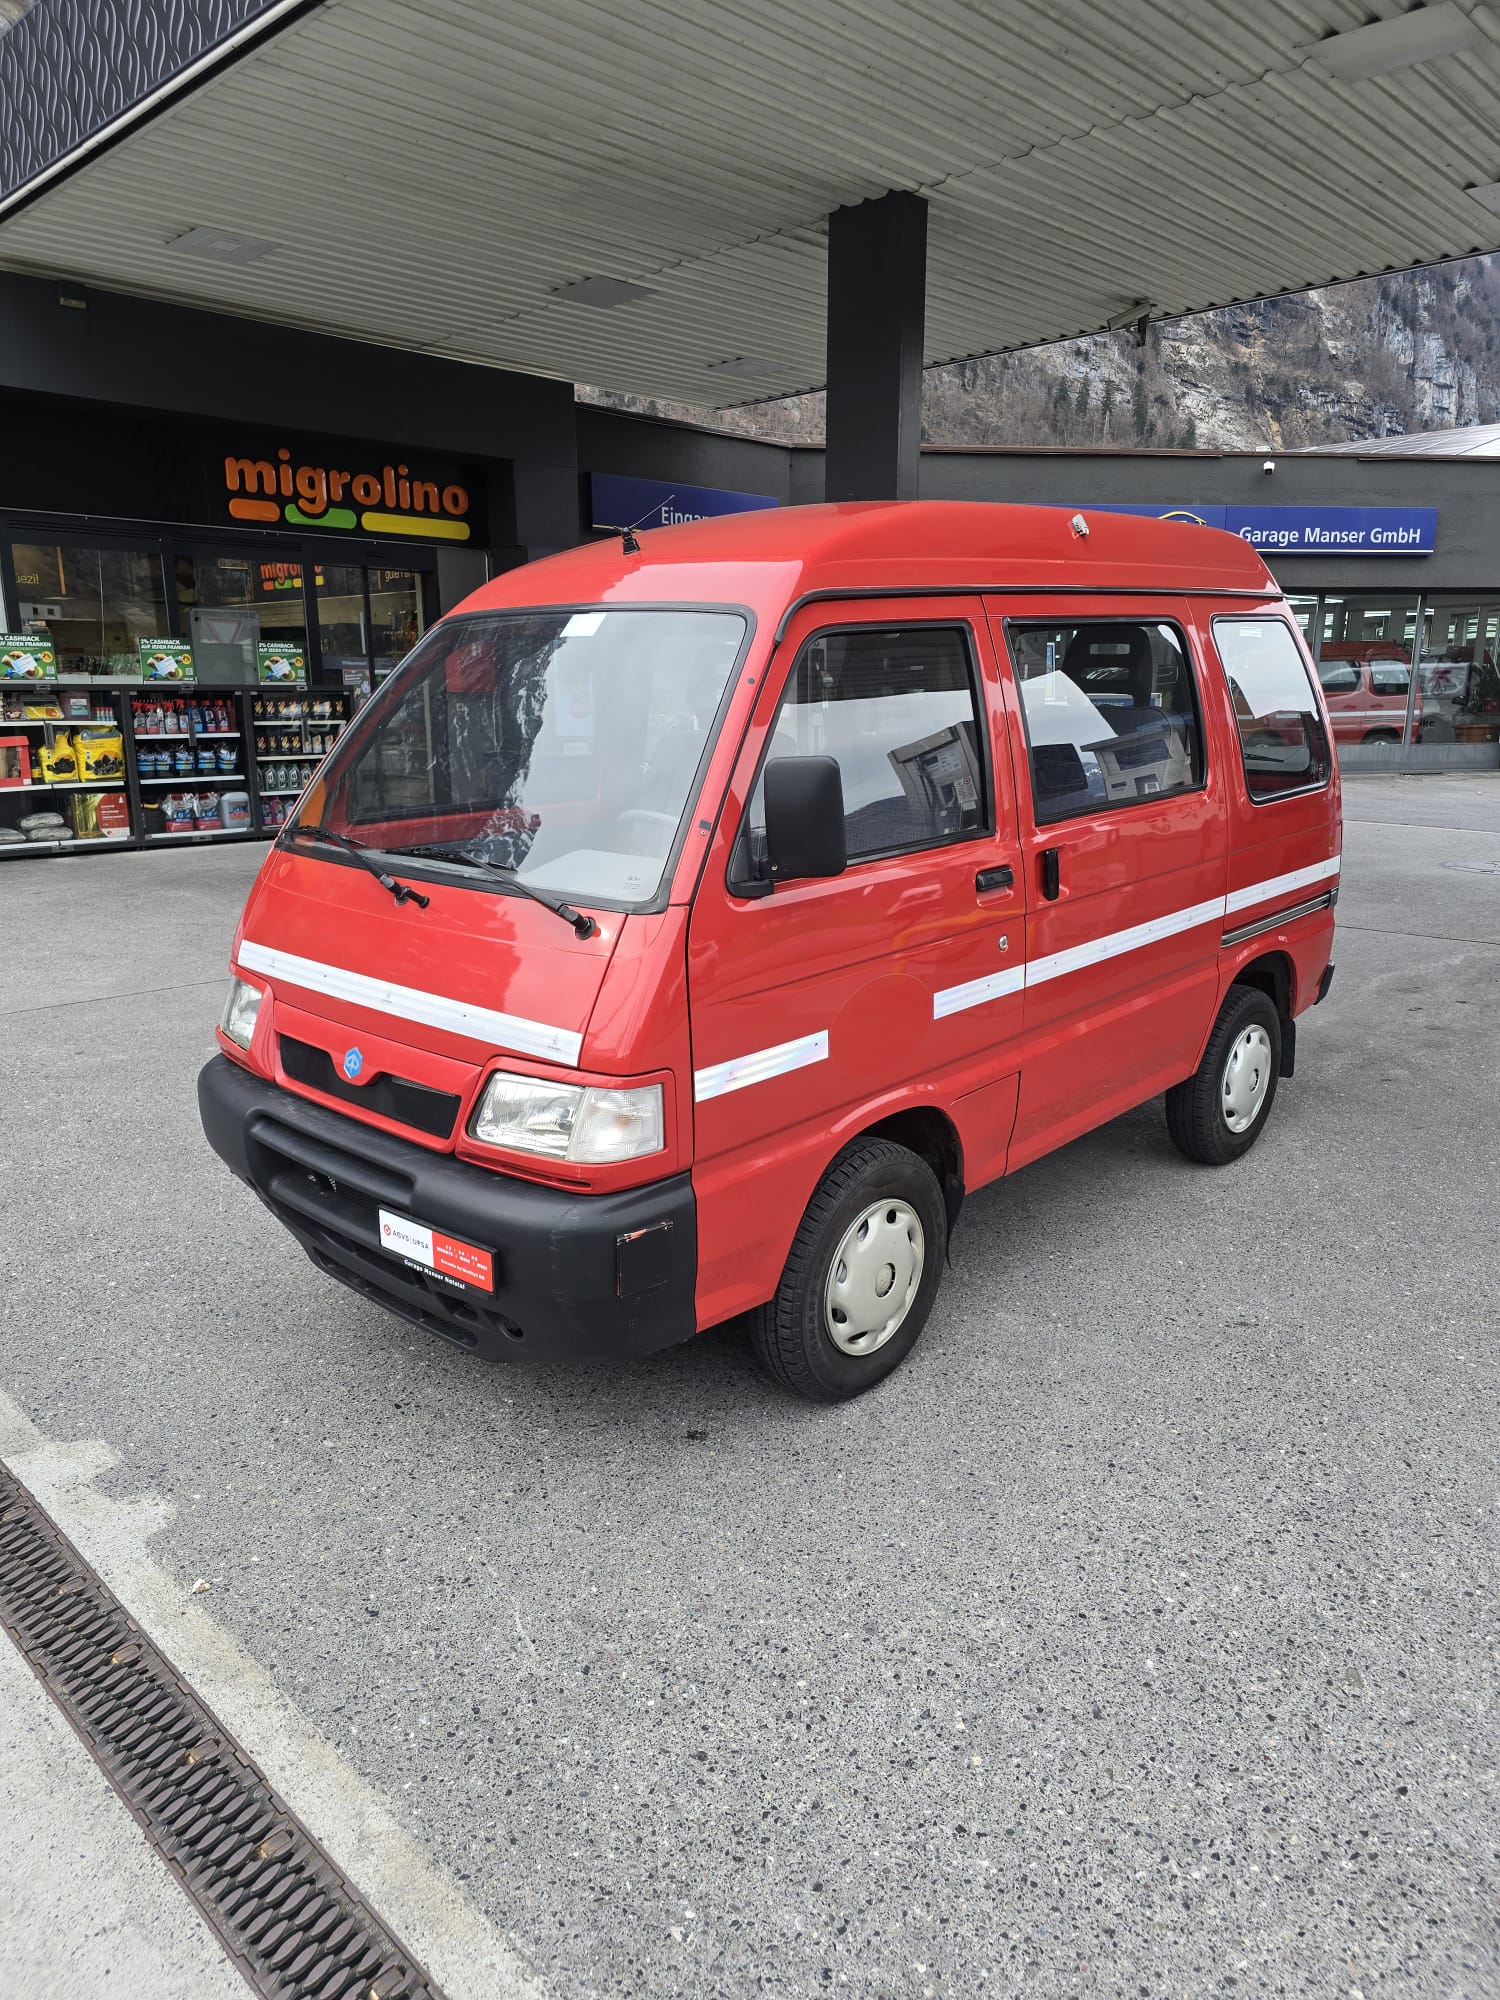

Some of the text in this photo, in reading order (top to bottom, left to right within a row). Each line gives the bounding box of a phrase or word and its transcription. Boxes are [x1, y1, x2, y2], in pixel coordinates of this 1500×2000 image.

[224, 448, 469, 515] migrolino
[1240, 526, 1421, 546] Garage Manser GmbH
[392, 1229, 409, 1242] AGVS
[404, 1259, 423, 1272] Garage
